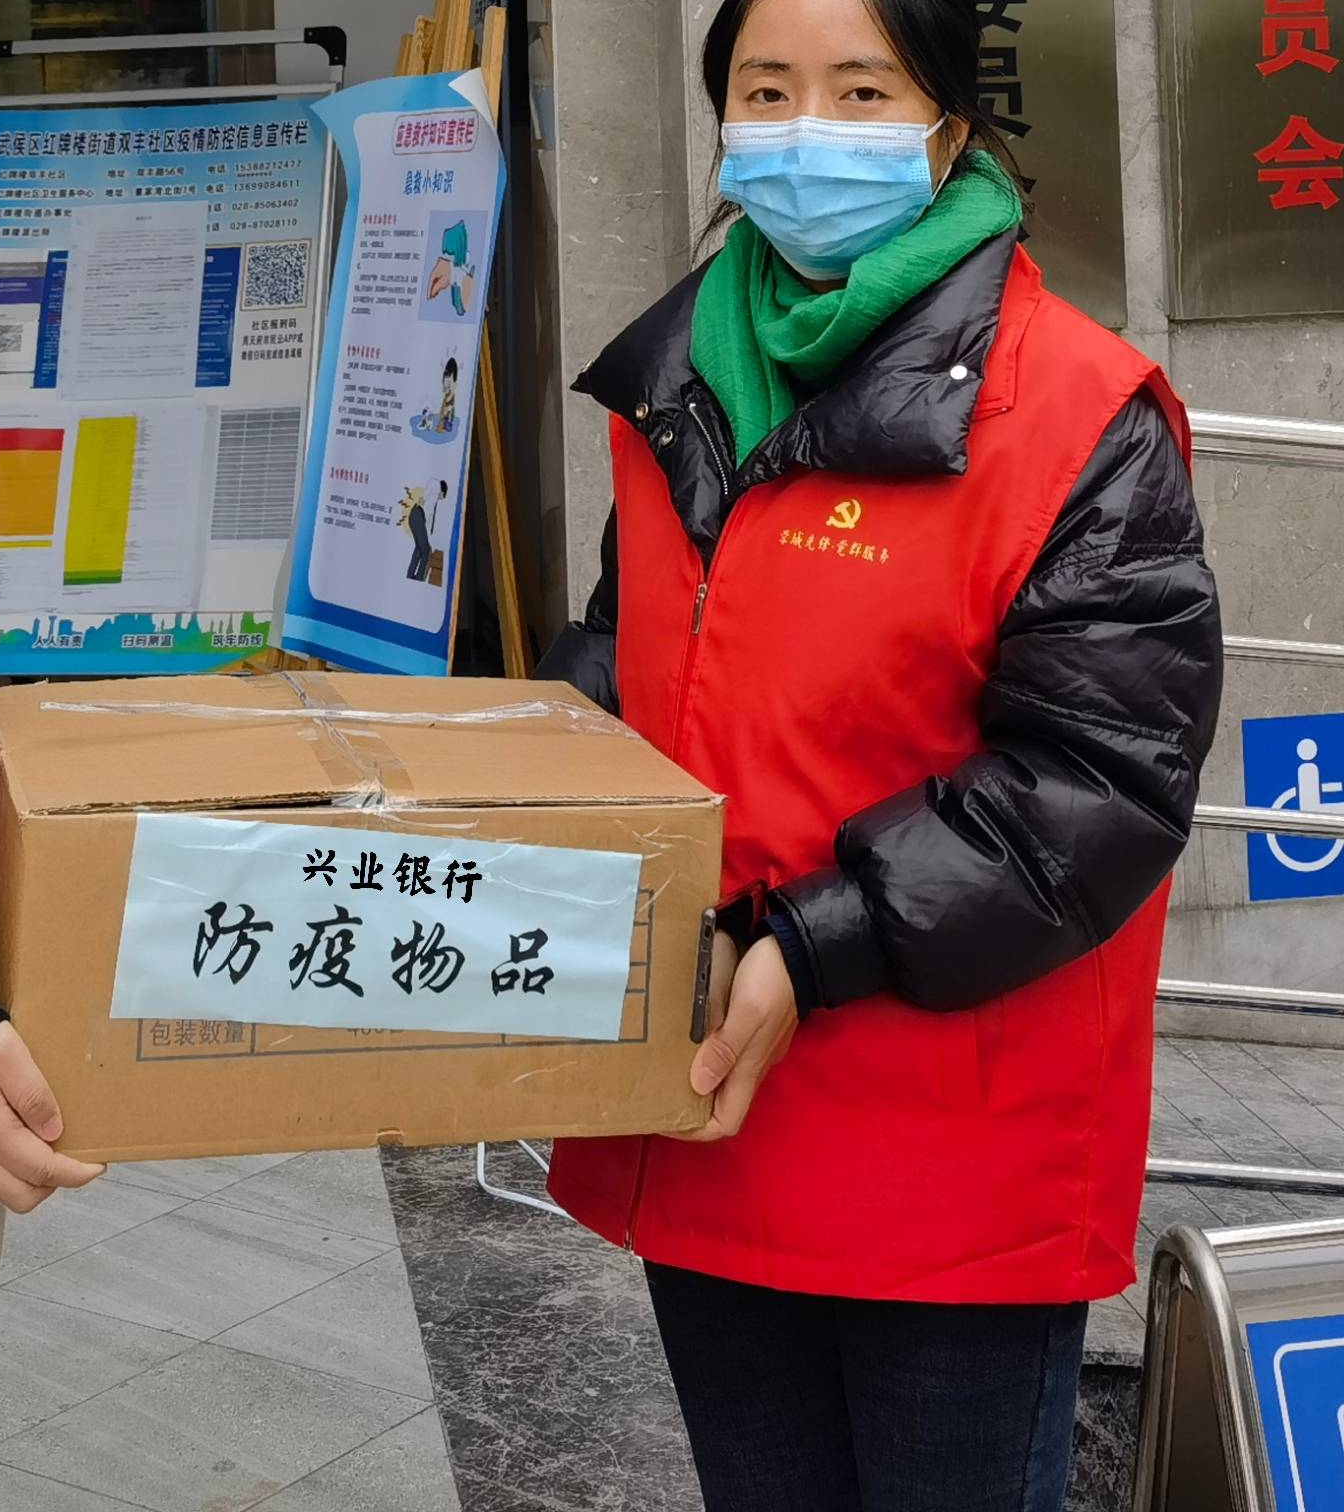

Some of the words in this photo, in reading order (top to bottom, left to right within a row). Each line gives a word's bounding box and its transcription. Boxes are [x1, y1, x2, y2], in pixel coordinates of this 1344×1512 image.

[404, 169, 454, 195] 急救小知识
[302, 848, 483, 904] 兴业银行
[192, 900, 556, 997] 防疫物品
